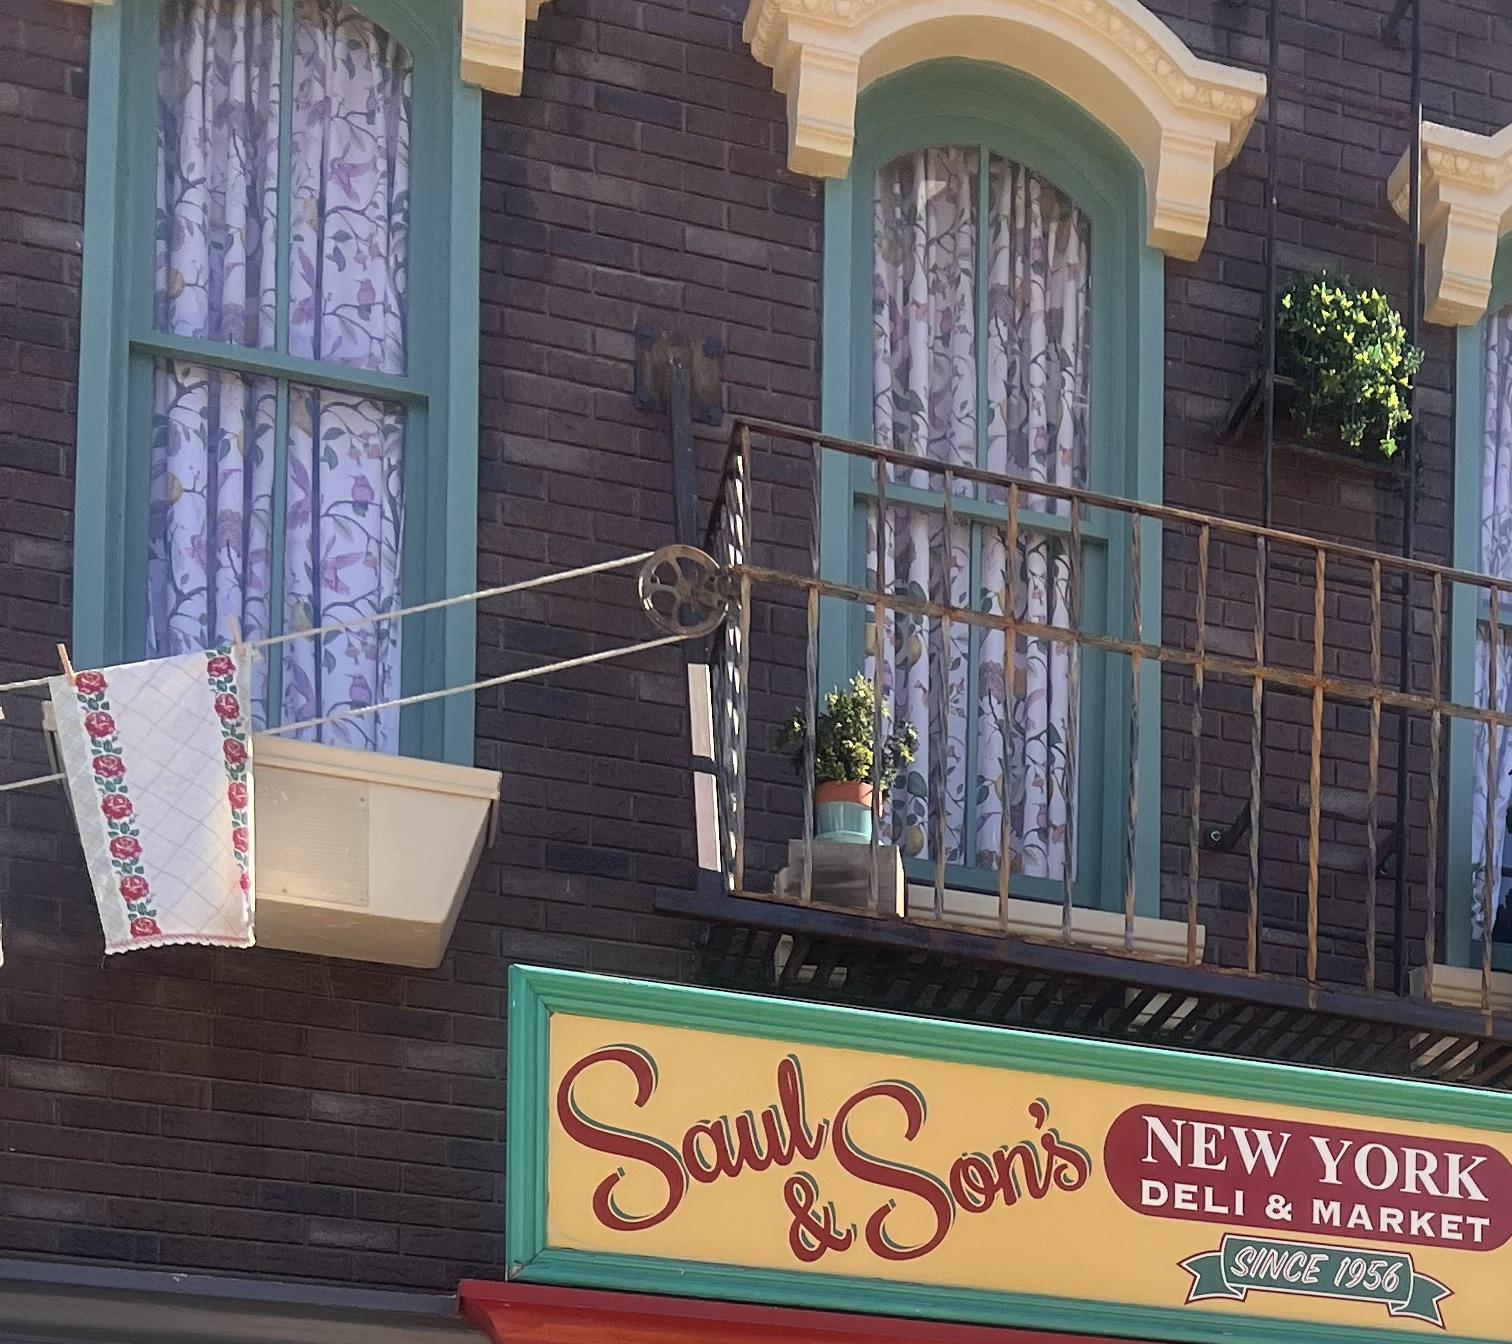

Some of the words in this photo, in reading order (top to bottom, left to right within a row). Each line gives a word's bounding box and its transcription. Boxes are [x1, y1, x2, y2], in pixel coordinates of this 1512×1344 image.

[557, 1043, 830, 1232] Saul
[783, 1171, 857, 1263] &
[831, 1078, 1092, 1261] Son's
[1141, 1115, 1291, 1178] NEW
[1310, 1136, 1490, 1202] YORK
[1140, 1179, 1245, 1216] DELI
[1265, 1195, 1293, 1222] &
[1312, 1200, 1491, 1243] MARKET
[1231, 1246, 1329, 1284] SINCE
[1333, 1256, 1404, 1293] 1956
